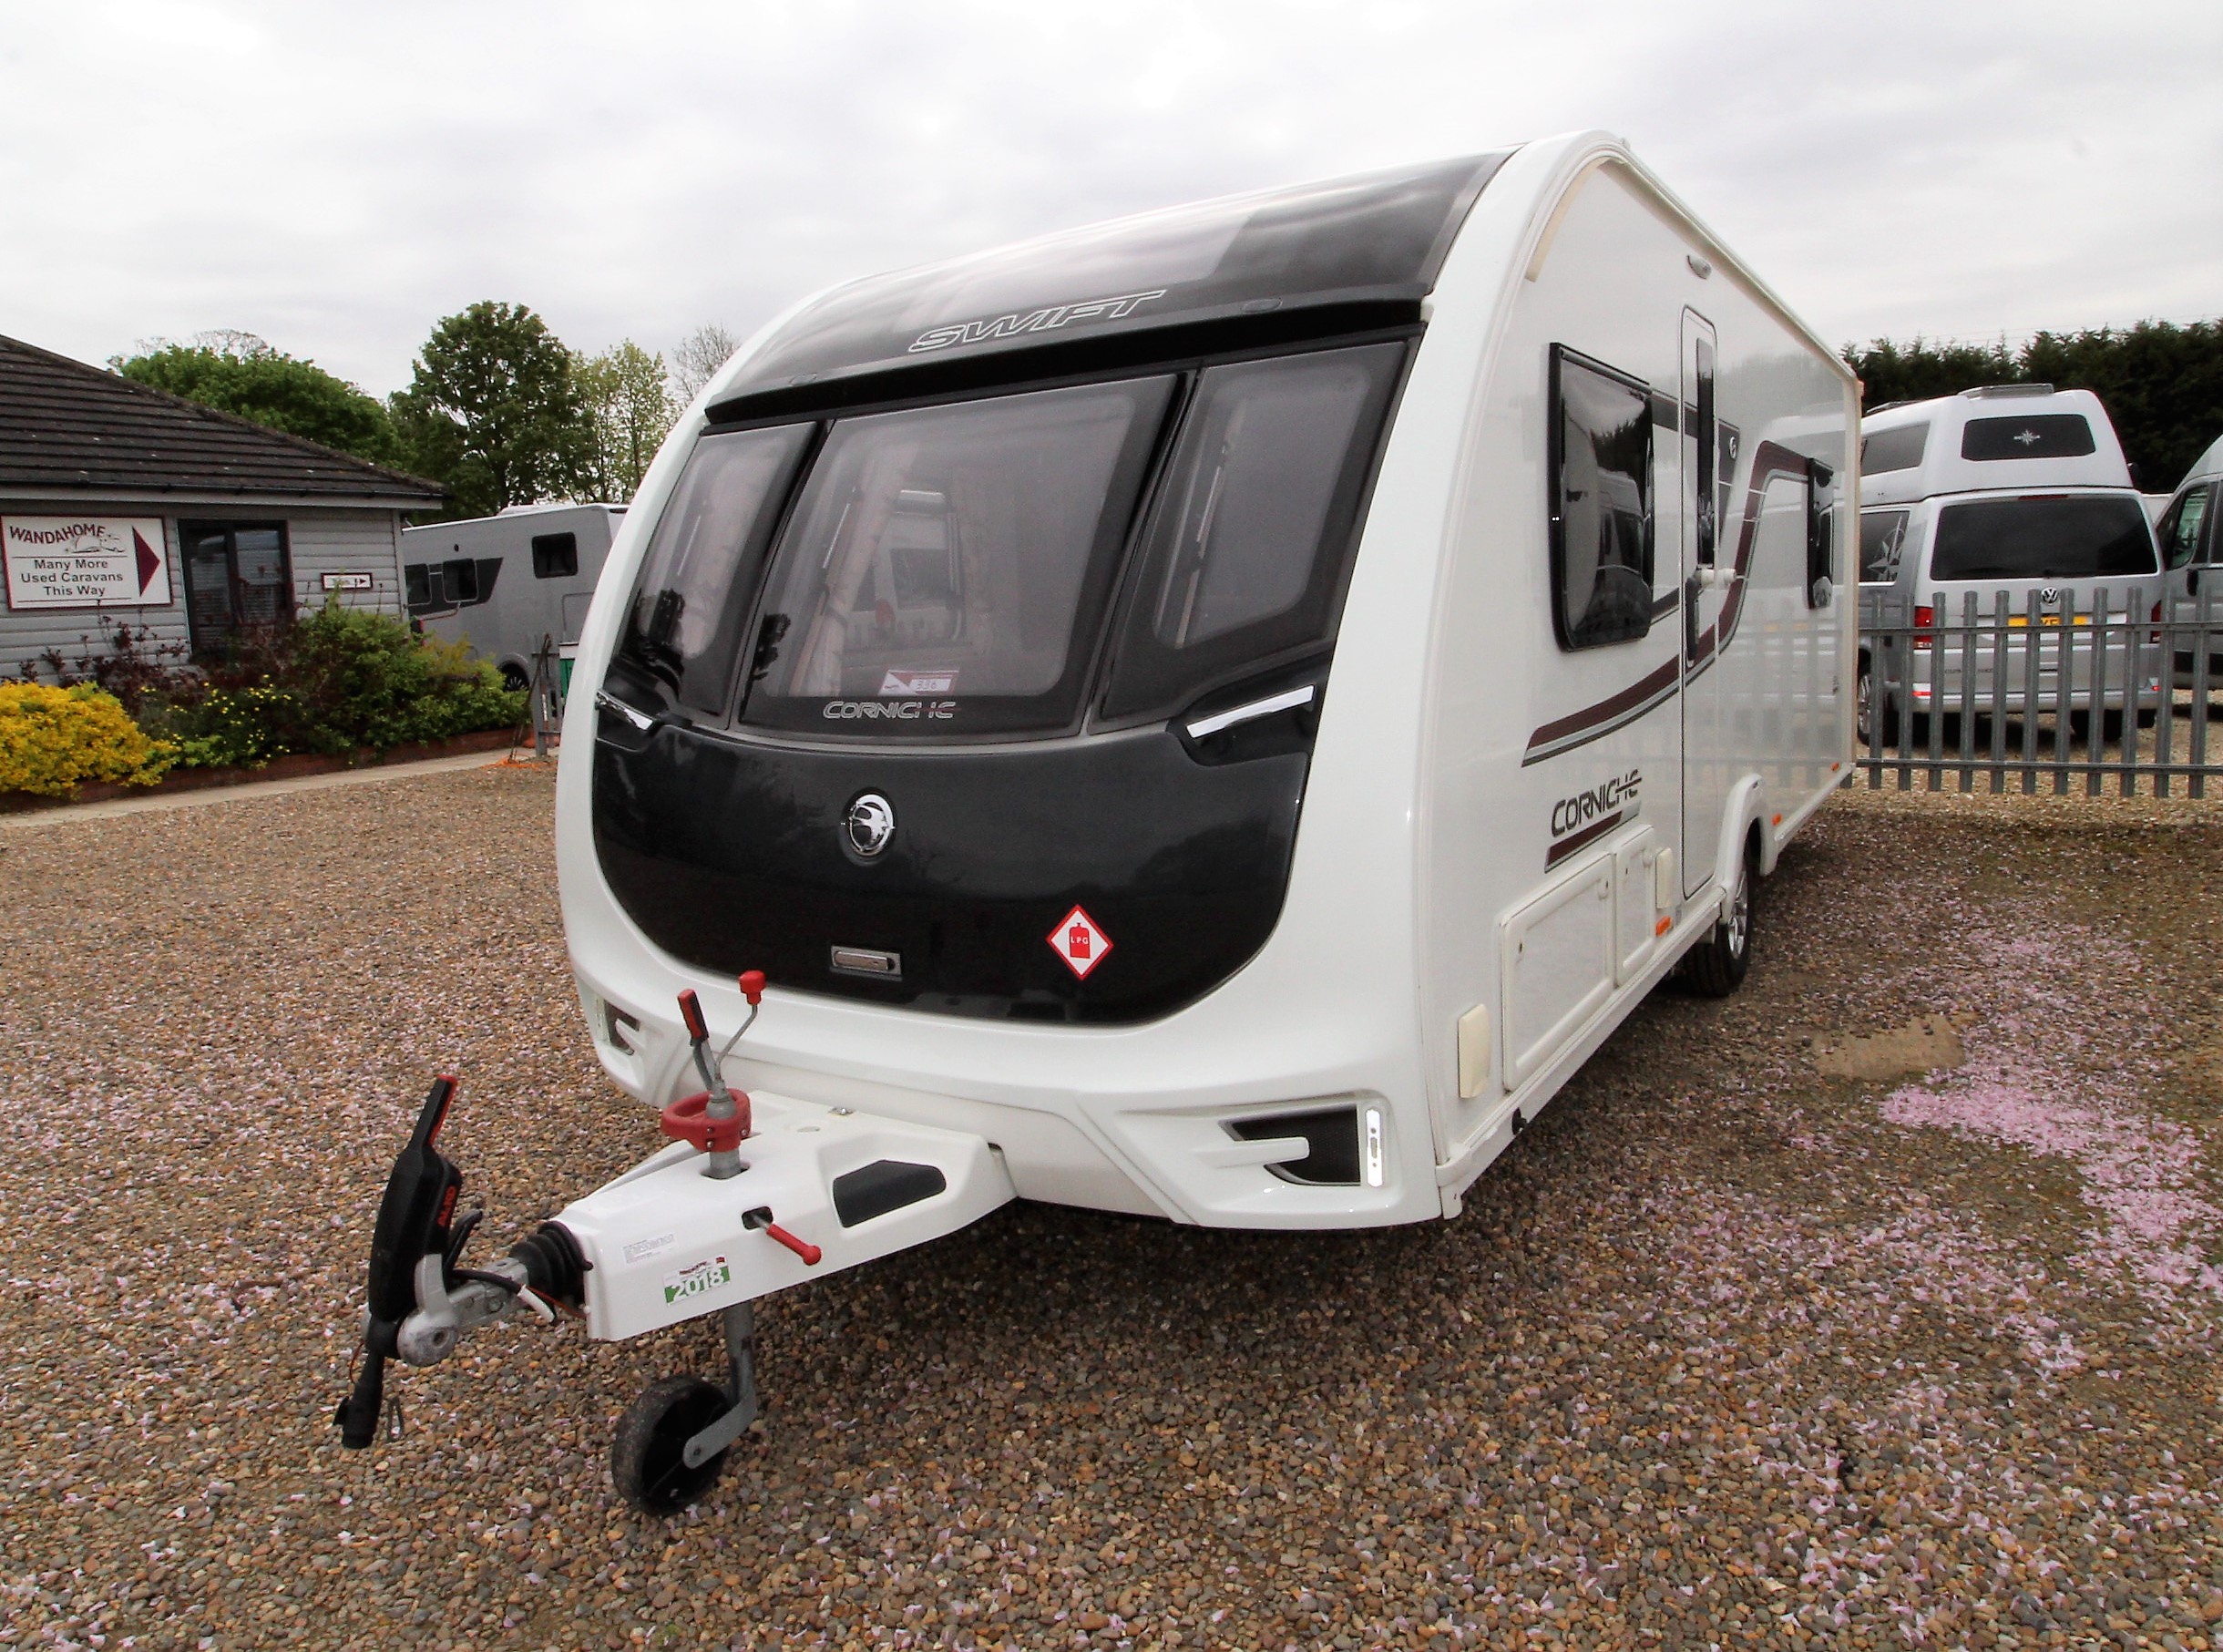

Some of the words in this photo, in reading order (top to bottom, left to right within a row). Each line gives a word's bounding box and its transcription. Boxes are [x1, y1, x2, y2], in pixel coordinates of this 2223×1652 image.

[908, 289, 1167, 353] SWIFT
[9, 523, 107, 545] WANDAHOME
[34, 559, 71, 571] Many
[75, 559, 109, 569] More
[21, 573, 56, 583] Used
[61, 572, 124, 583] Caravans
[44, 586, 73, 596] This
[77, 586, 106, 598] Way
[1071, 936, 1089, 945] LPG
[670, 1267, 724, 1302] 2018
